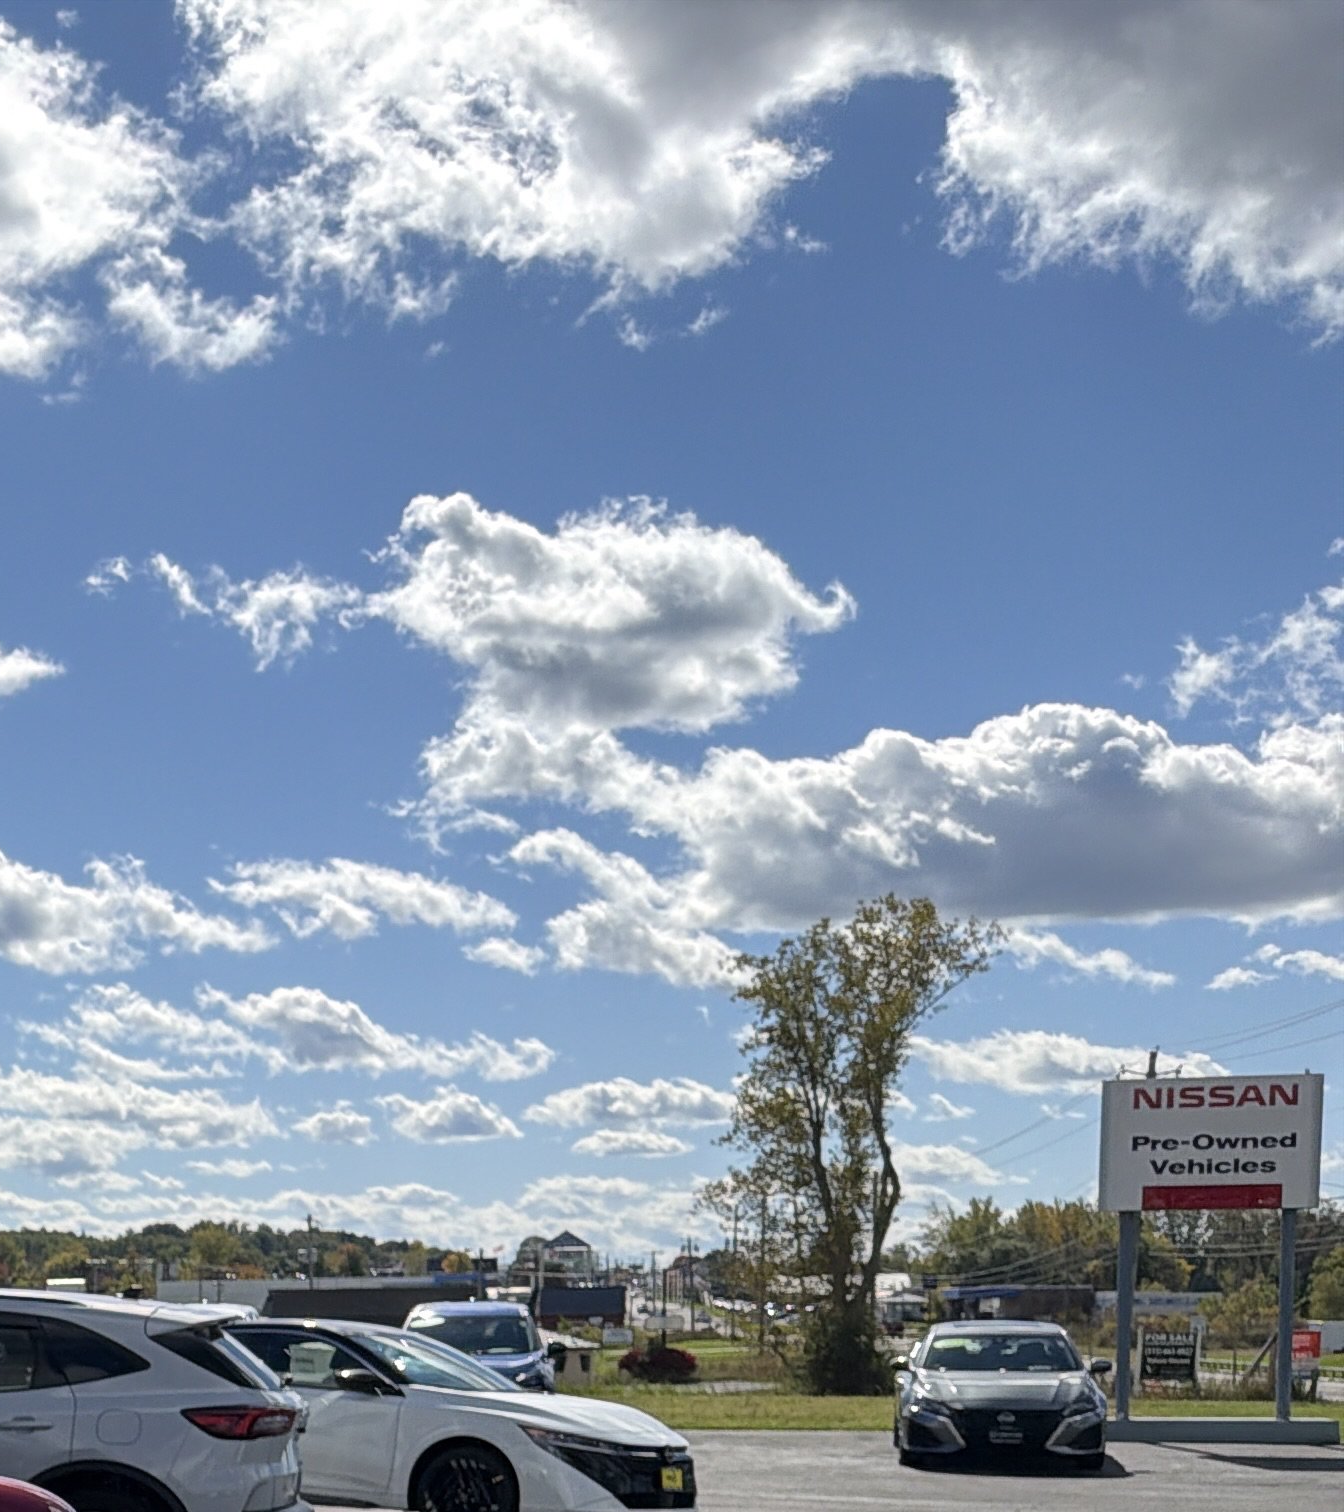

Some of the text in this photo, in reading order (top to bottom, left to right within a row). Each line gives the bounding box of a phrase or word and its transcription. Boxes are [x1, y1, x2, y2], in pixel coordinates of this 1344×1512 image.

[1133, 1083, 1299, 1110] NISSAN
[1131, 1132, 1297, 1151] Pre-Owned
[1149, 1158, 1277, 1175] Vehicles
[1169, 1333, 1194, 1342] SALE
